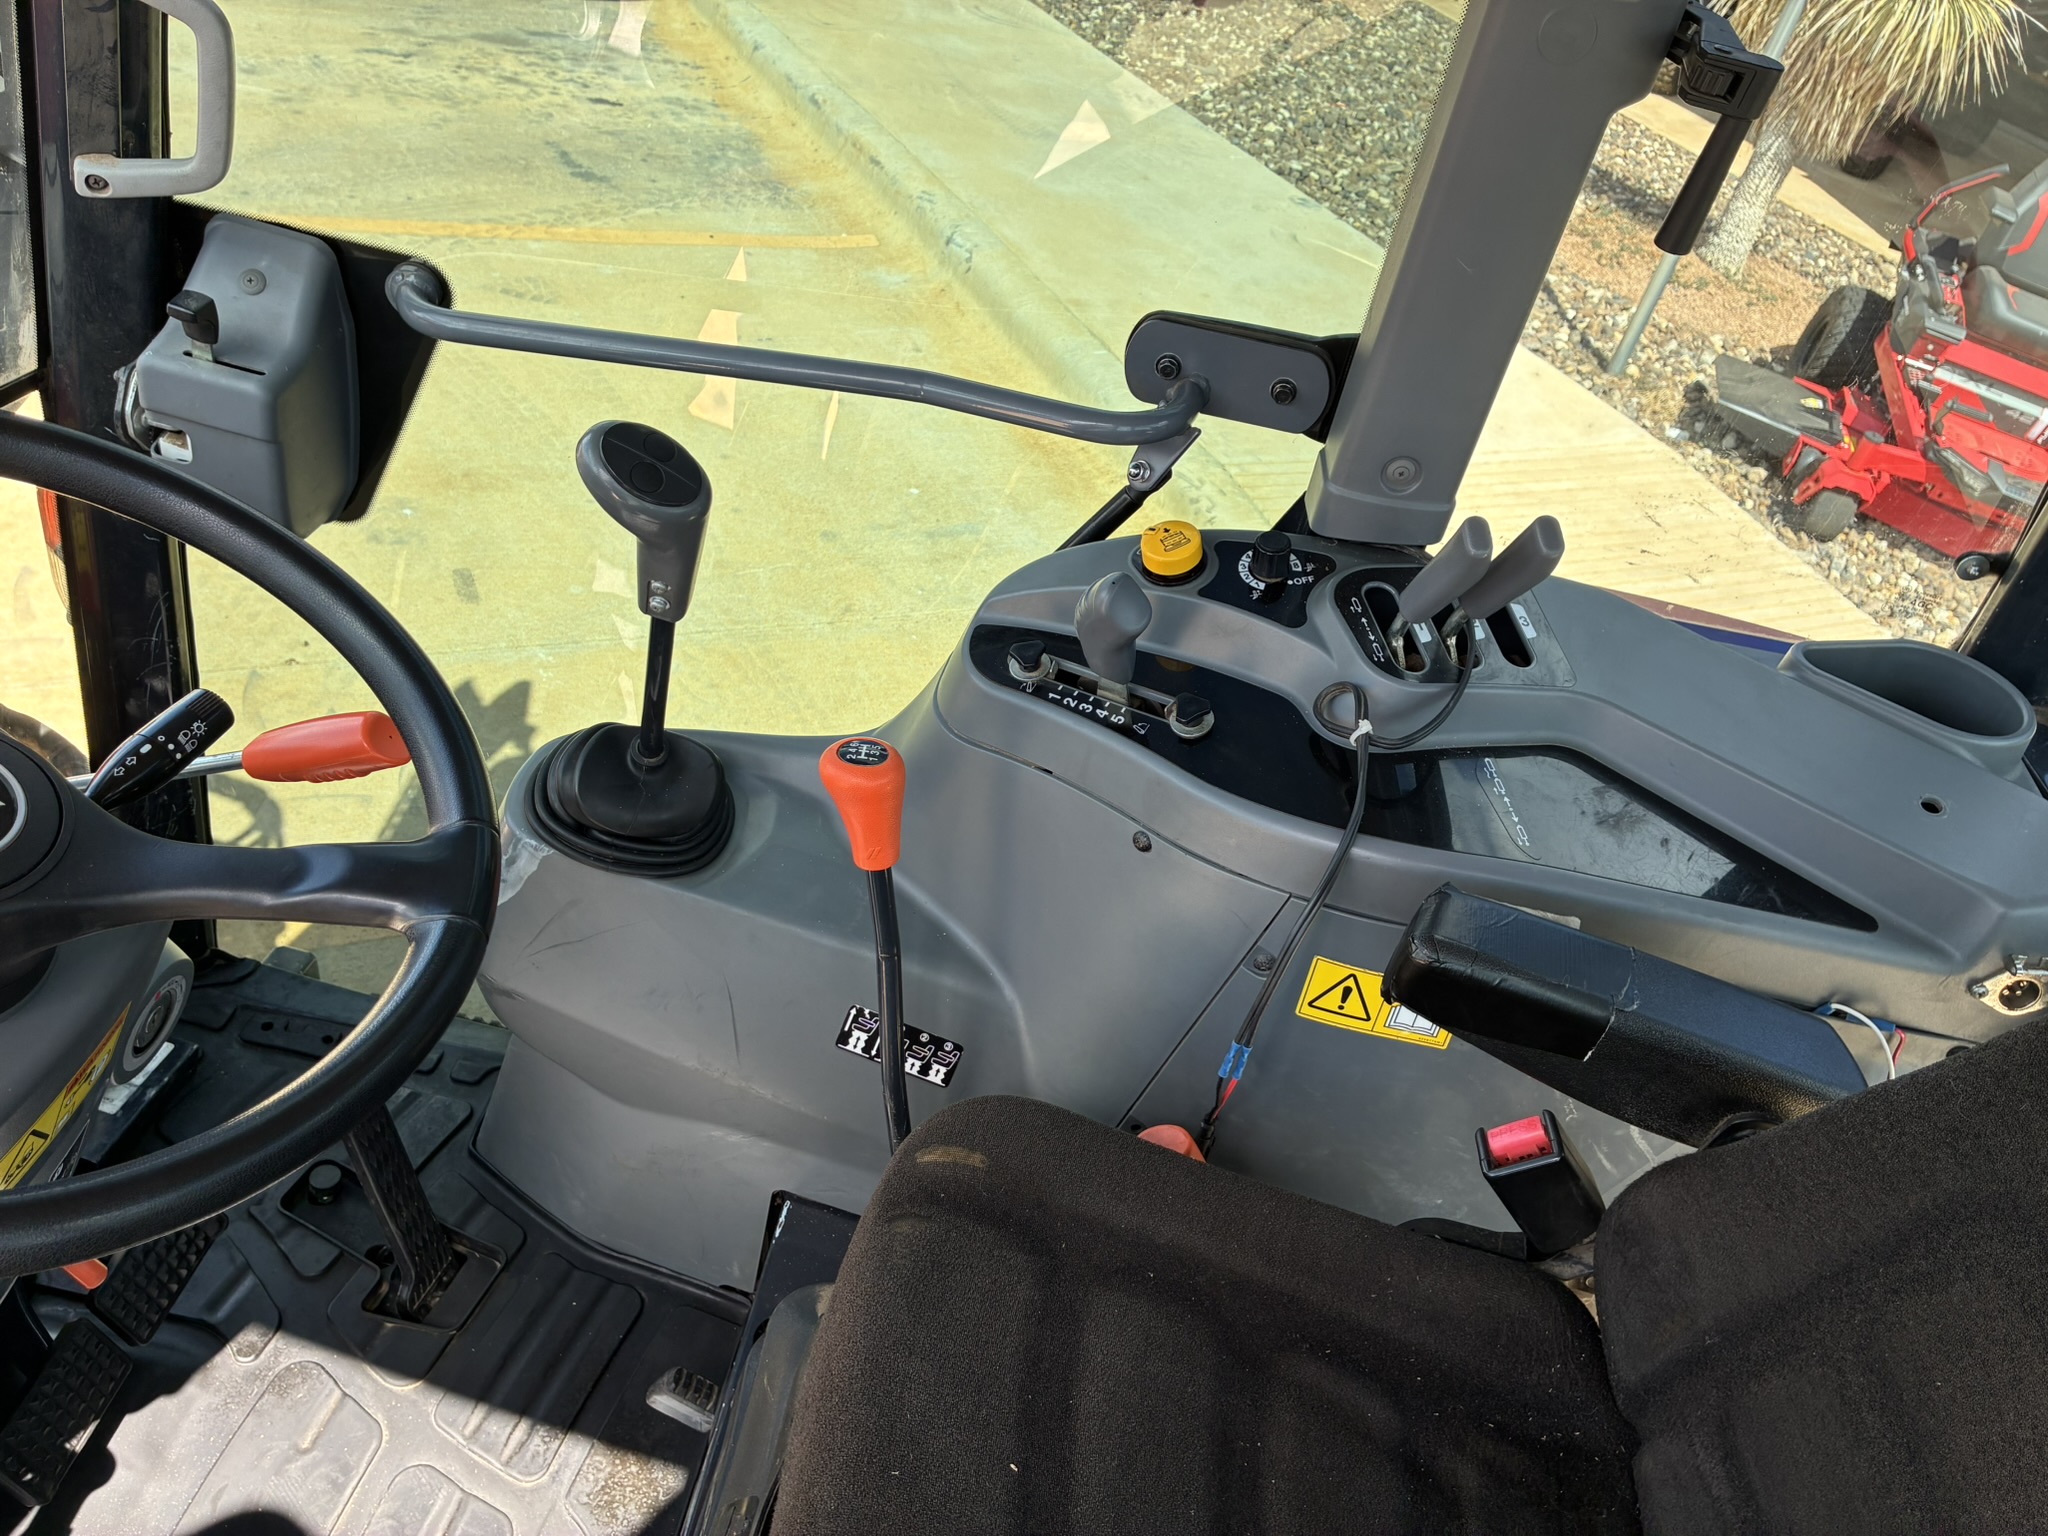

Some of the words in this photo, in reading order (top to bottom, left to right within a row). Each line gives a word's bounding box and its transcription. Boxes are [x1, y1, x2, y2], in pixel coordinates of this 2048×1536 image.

[1294, 575, 1315, 585] OFF
[1518, 615, 1530, 627] 3
[1063, 697, 1078, 708] 2
[1078, 703, 1093, 713] 3
[1096, 708, 1110, 718] 4
[1110, 714, 1125, 724] 5
[1490, 1118, 1538, 1142] PRESS
